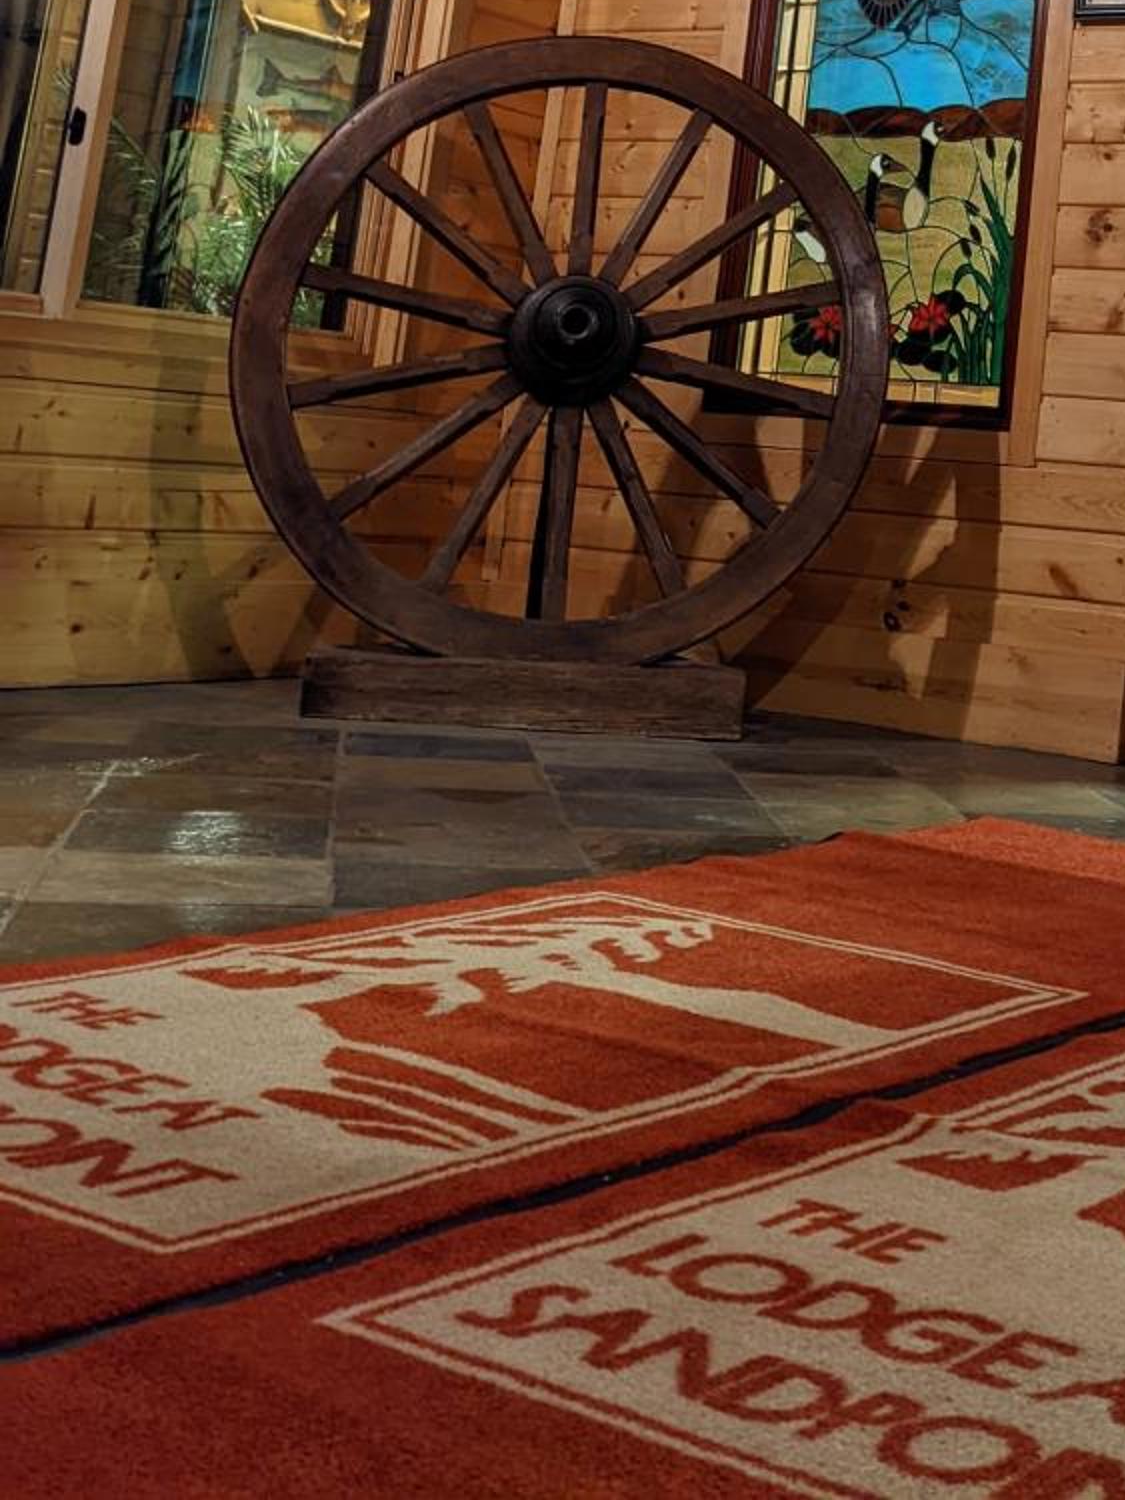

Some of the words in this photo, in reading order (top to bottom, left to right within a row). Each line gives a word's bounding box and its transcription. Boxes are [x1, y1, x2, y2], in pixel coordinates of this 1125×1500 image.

[9, 991, 165, 1031] THE
[111, 1099, 263, 1131] AT
[760, 1199, 948, 1266] THE
[609, 1233, 1081, 1389] LODGE
